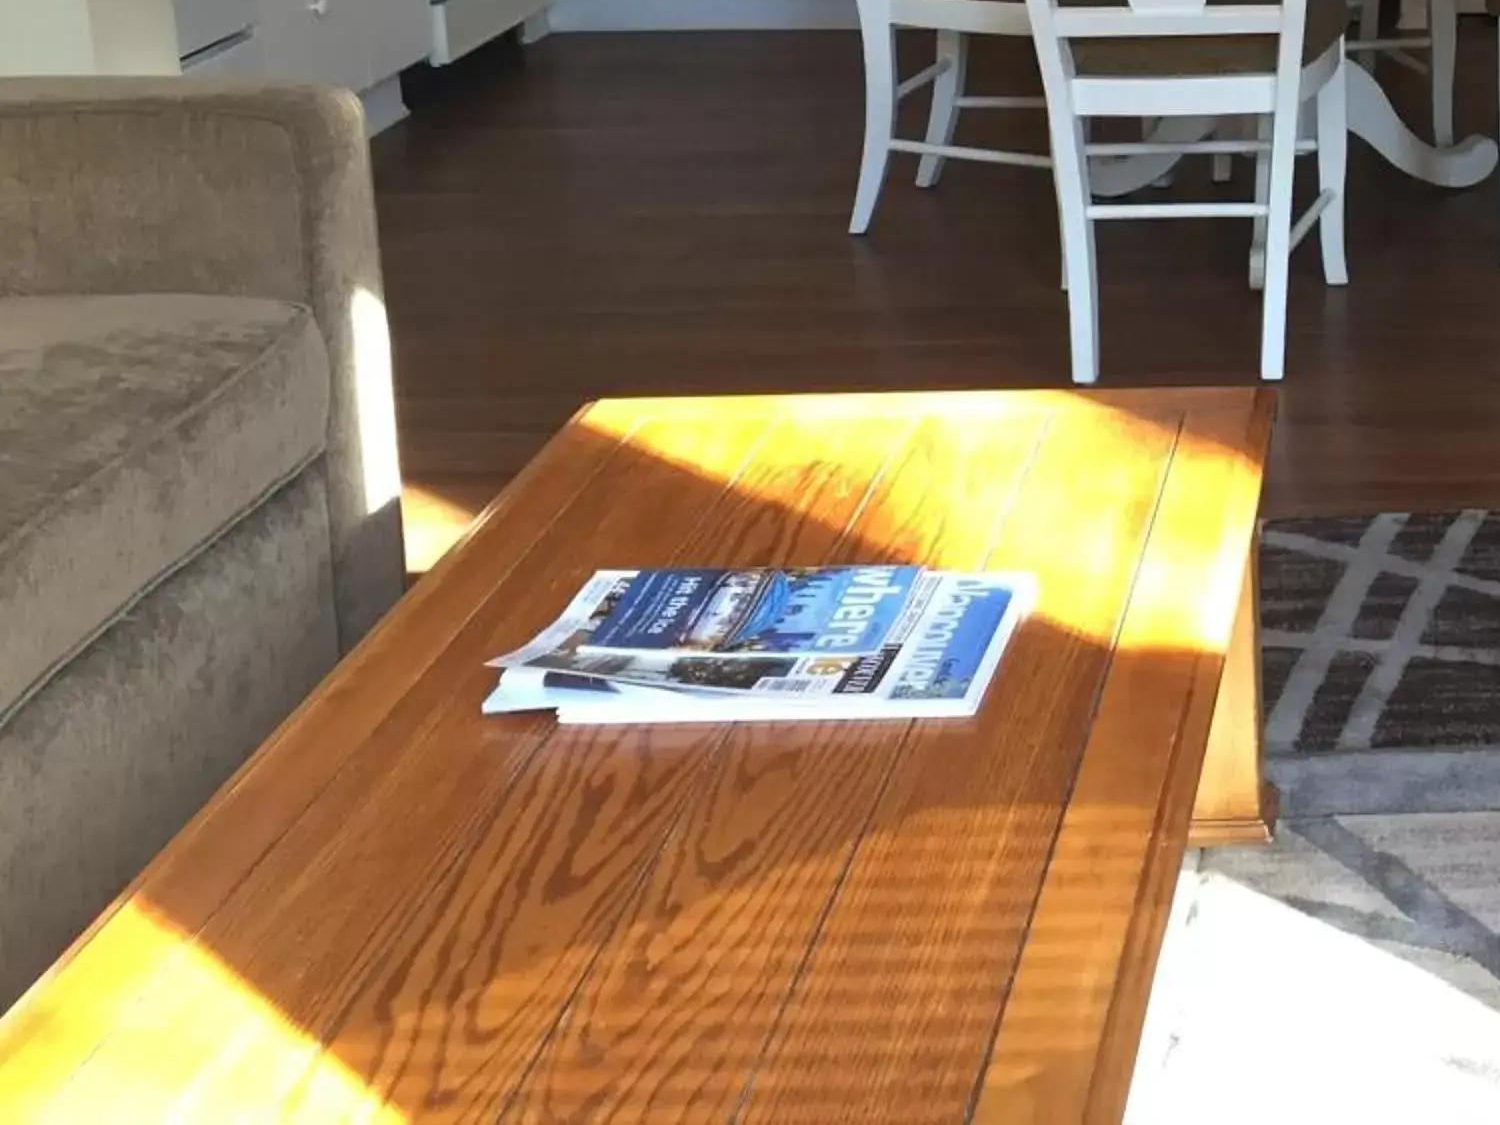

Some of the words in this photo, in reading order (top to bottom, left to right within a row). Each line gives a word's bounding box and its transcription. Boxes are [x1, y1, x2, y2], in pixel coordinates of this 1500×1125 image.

[661, 596, 689, 617] the
[815, 565, 901, 650] where
[899, 578, 993, 690] Vancouver
